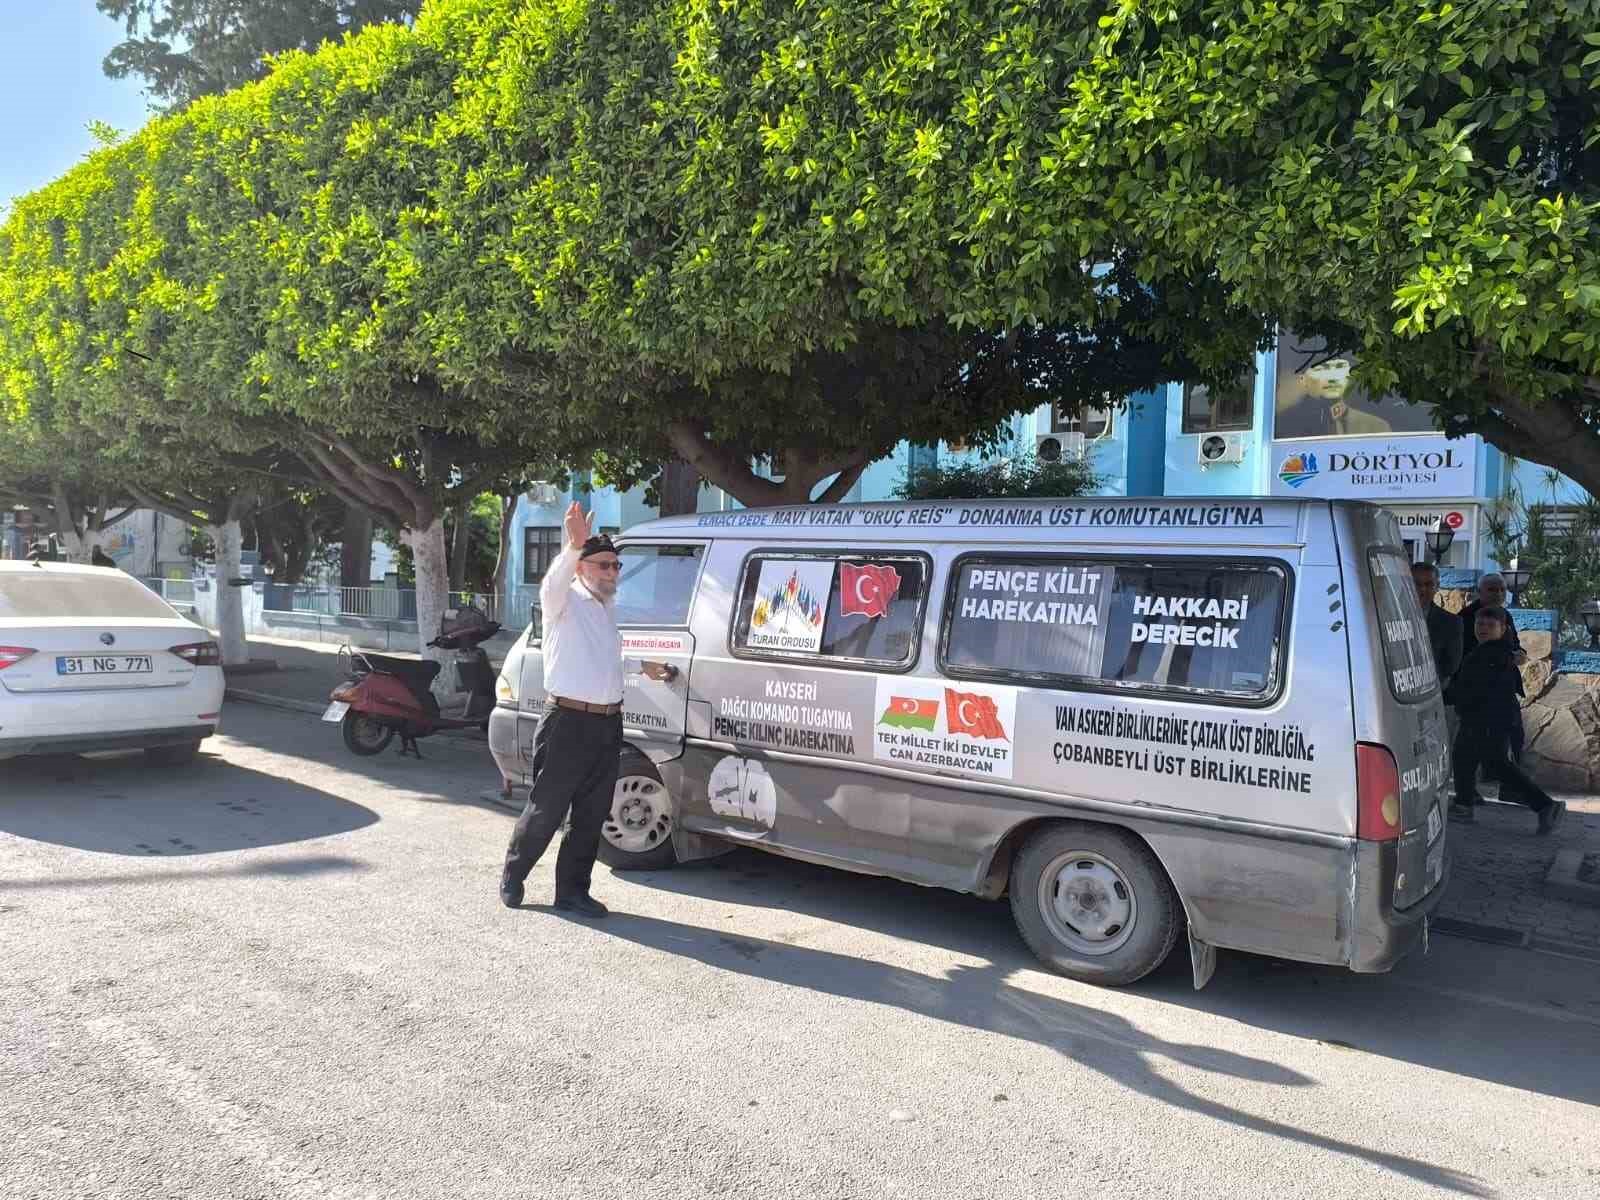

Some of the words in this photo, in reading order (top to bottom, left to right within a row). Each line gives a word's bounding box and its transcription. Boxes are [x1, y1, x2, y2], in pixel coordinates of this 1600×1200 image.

[1328, 449, 1463, 472] DÖRTYOL
[1351, 471, 1437, 485] BELEDİYESİ
[737, 513, 767, 526] DEDE
[771, 508, 808, 525] MAVİ
[809, 510, 853, 524] VATAN
[958, 508, 1042, 525] DONANMA
[1050, 504, 1086, 525] ÜST
[1089, 503, 1264, 525] KOMUTANLIĞI'NA
[969, 569, 1039, 597] PENÇE
[1044, 566, 1101, 594] KİLİT
[961, 598, 1099, 625] HAREKATINA
[1132, 595, 1248, 620] HAKKARİ
[752, 633, 779, 646] TURAN
[781, 636, 816, 648] ORDUSU
[1131, 622, 1241, 649] DERECİK
[66, 659, 83, 672] 31
[93, 658, 116, 671] NG
[125, 657, 151, 671] 771
[765, 679, 817, 701] KAYSERİ
[720, 696, 749, 718] DAĞCI
[750, 701, 799, 723] KOMANDO
[801, 707, 853, 730] TUGAYINA
[714, 717, 747, 741] PENÇE
[748, 722, 782, 746] KILINÇ
[784, 727, 855, 755] HAREKATINA
[1055, 706, 1076, 731] VAN
[1077, 706, 1115, 738] ASKERİ
[1116, 707, 1189, 746] BİRLİKLERİNE
[1191, 719, 1228, 751] ÇATAK
[1230, 719, 1253, 753] ÜST
[877, 732, 898, 745] TEK
[900, 733, 941, 750] MİLLET
[943, 738, 959, 753] İKİ
[962, 743, 1009, 760] DEVLET
[889, 748, 913, 761] CAN
[916, 751, 993, 773] AZERBAYCAN
[1053, 741, 1148, 772] ÇOBANBEYLİ
[1154, 751, 1186, 776] ÜST
[1190, 755, 1312, 794] BİRLİKLERİNE
